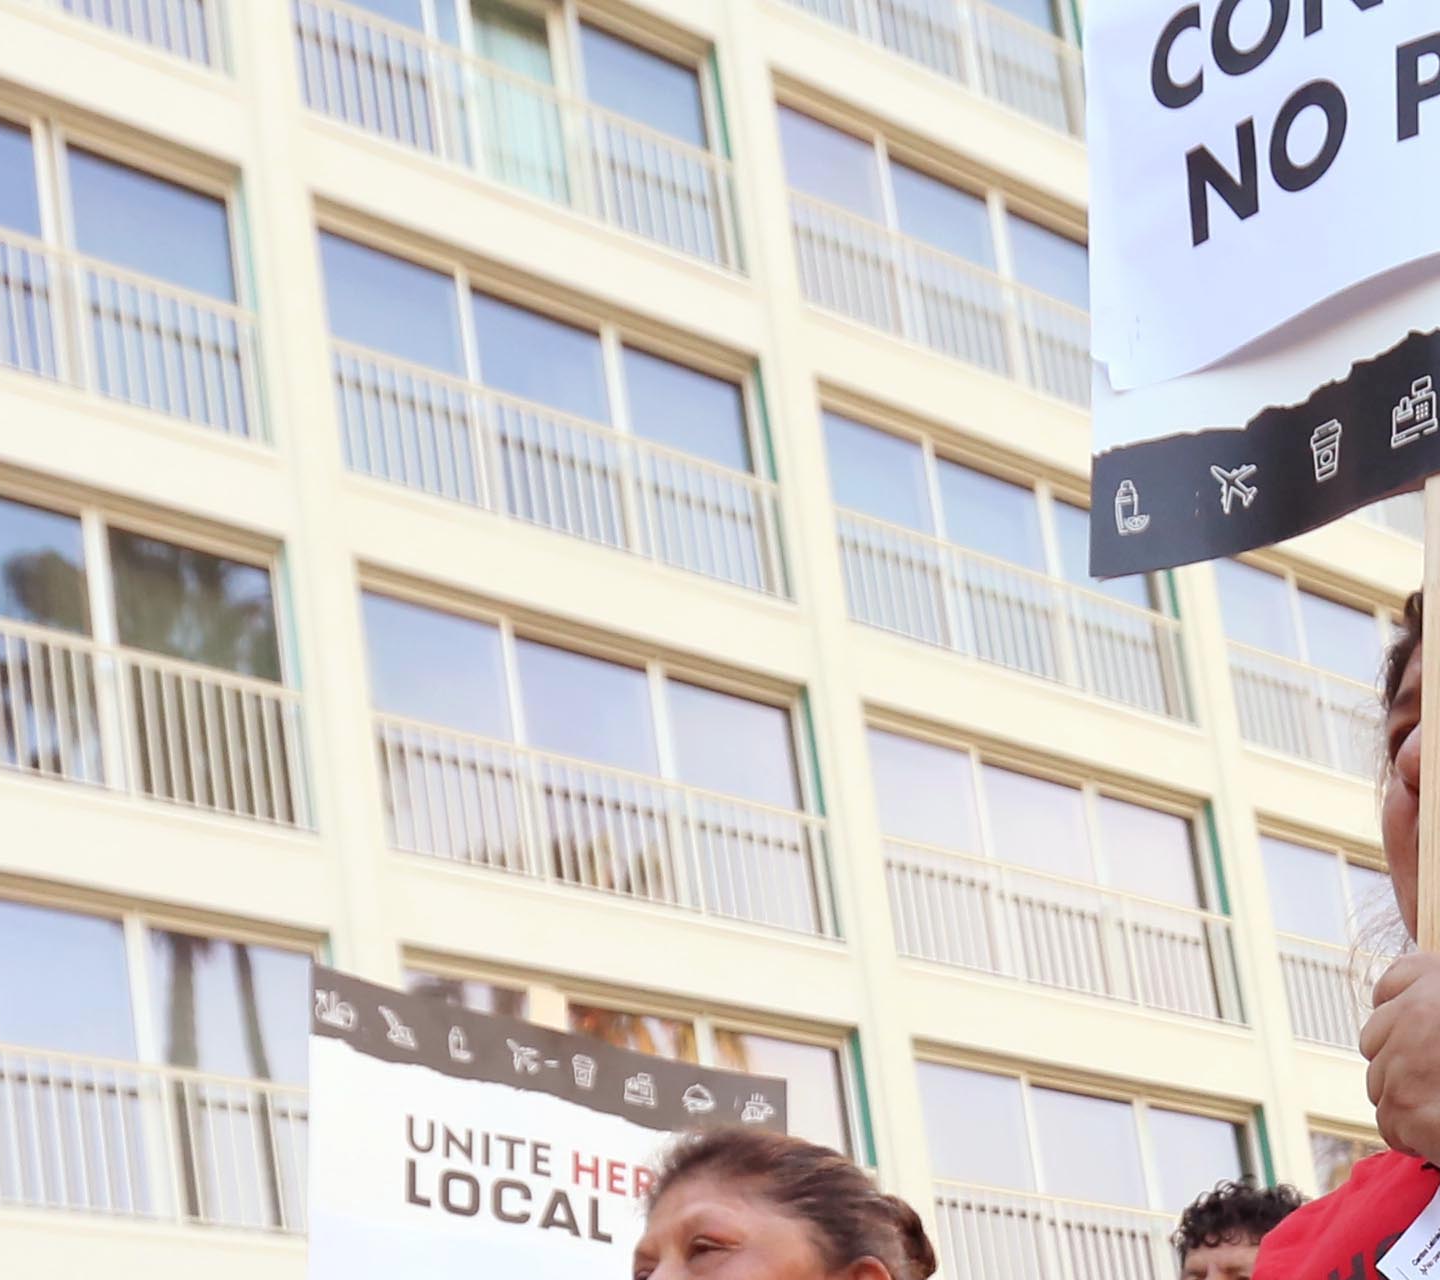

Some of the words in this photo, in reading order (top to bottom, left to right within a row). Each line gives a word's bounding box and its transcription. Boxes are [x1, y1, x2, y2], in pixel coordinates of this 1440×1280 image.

[1151, 0, 1383, 109] CO
[1185, 78, 1348, 247] NO
[404, 1115, 552, 1178] UNITE
[404, 1159, 613, 1244] LOCAL
